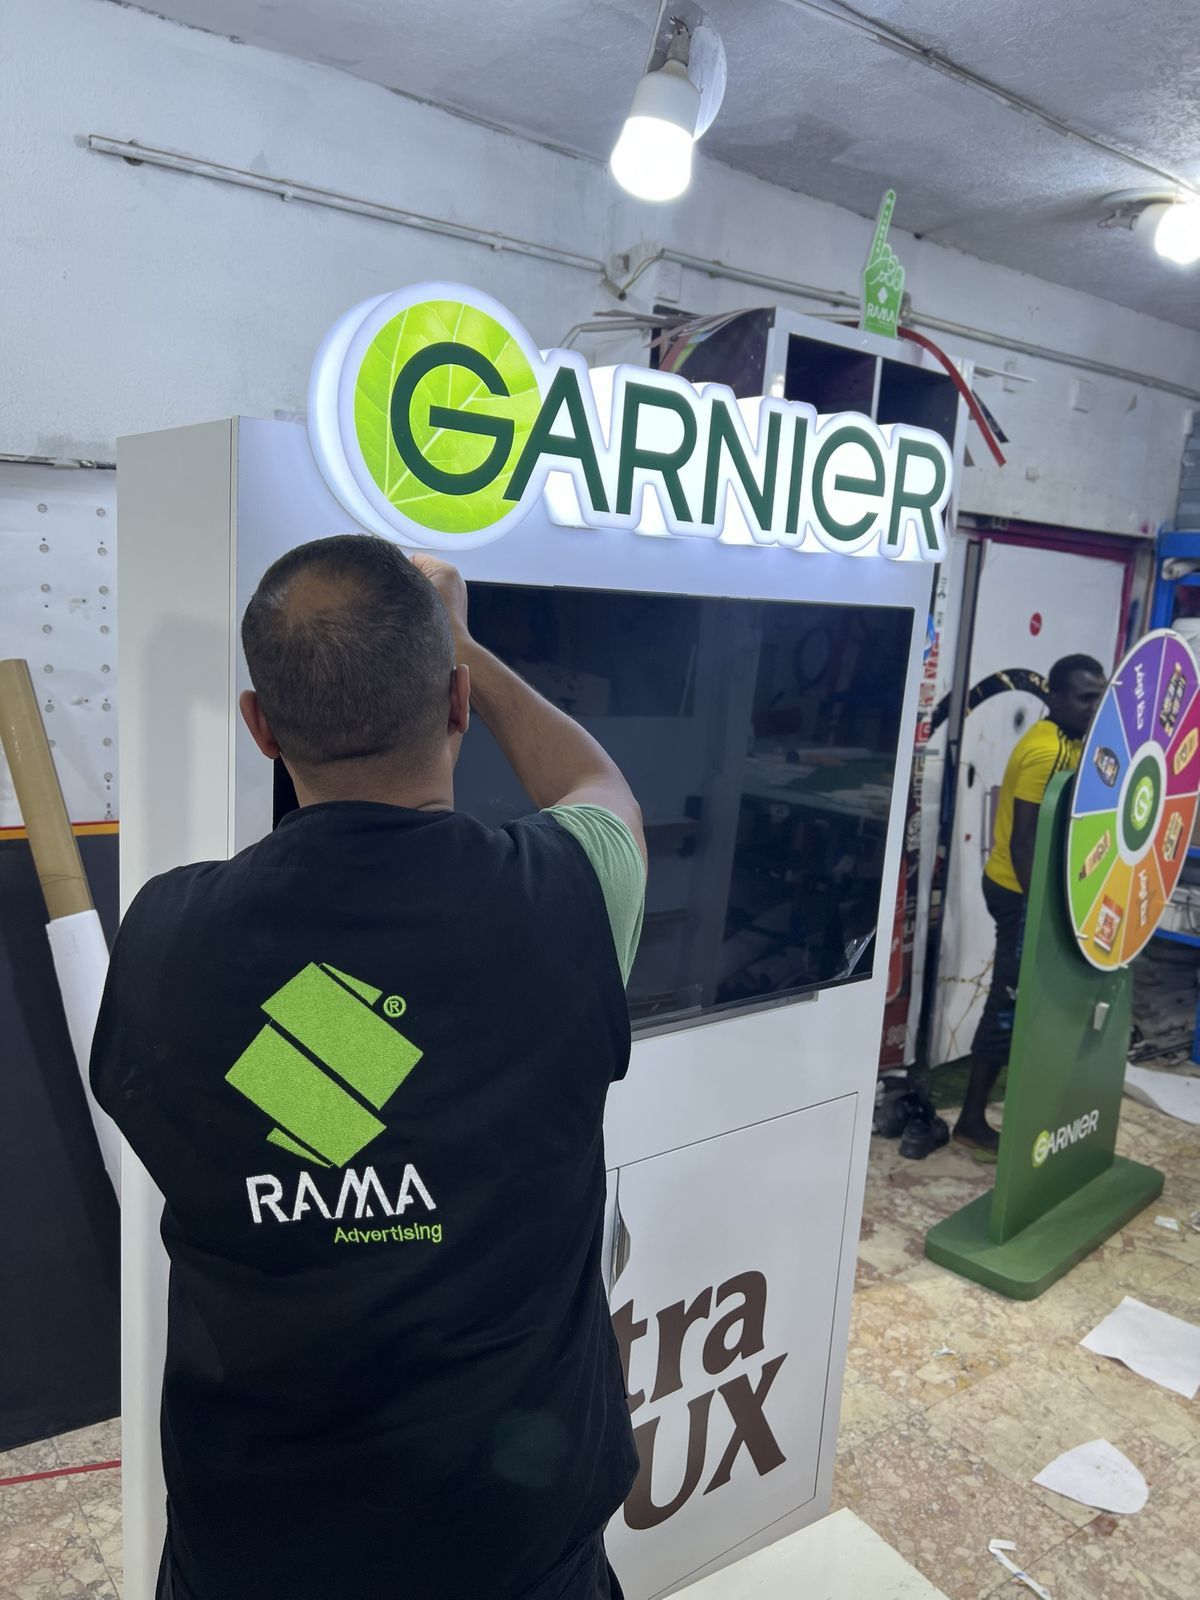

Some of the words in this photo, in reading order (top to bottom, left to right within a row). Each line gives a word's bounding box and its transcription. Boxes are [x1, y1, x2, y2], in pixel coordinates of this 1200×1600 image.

[867, 303, 895, 323] RAMA
[246, 1163, 437, 1225] RAMA
[334, 1222, 443, 1243] Advertising
